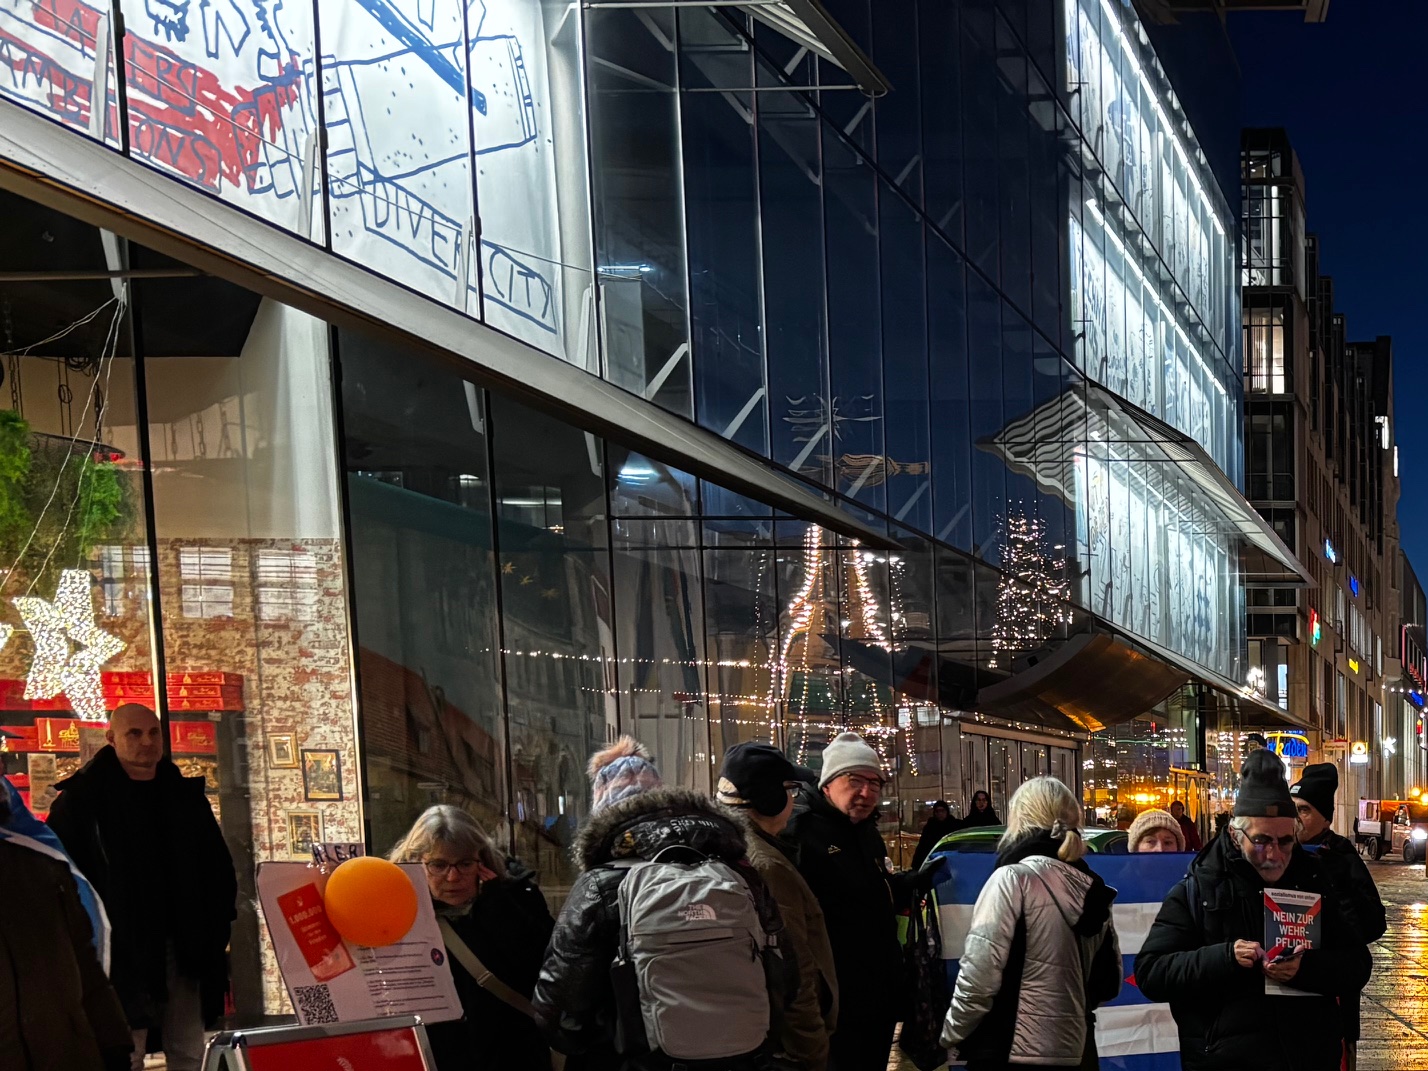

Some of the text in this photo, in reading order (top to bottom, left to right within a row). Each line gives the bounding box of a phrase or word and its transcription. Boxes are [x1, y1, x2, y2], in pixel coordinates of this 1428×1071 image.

[1273, 910, 1314, 925] NEIN ZUR
[1279, 924, 1310, 937] WEHR-
